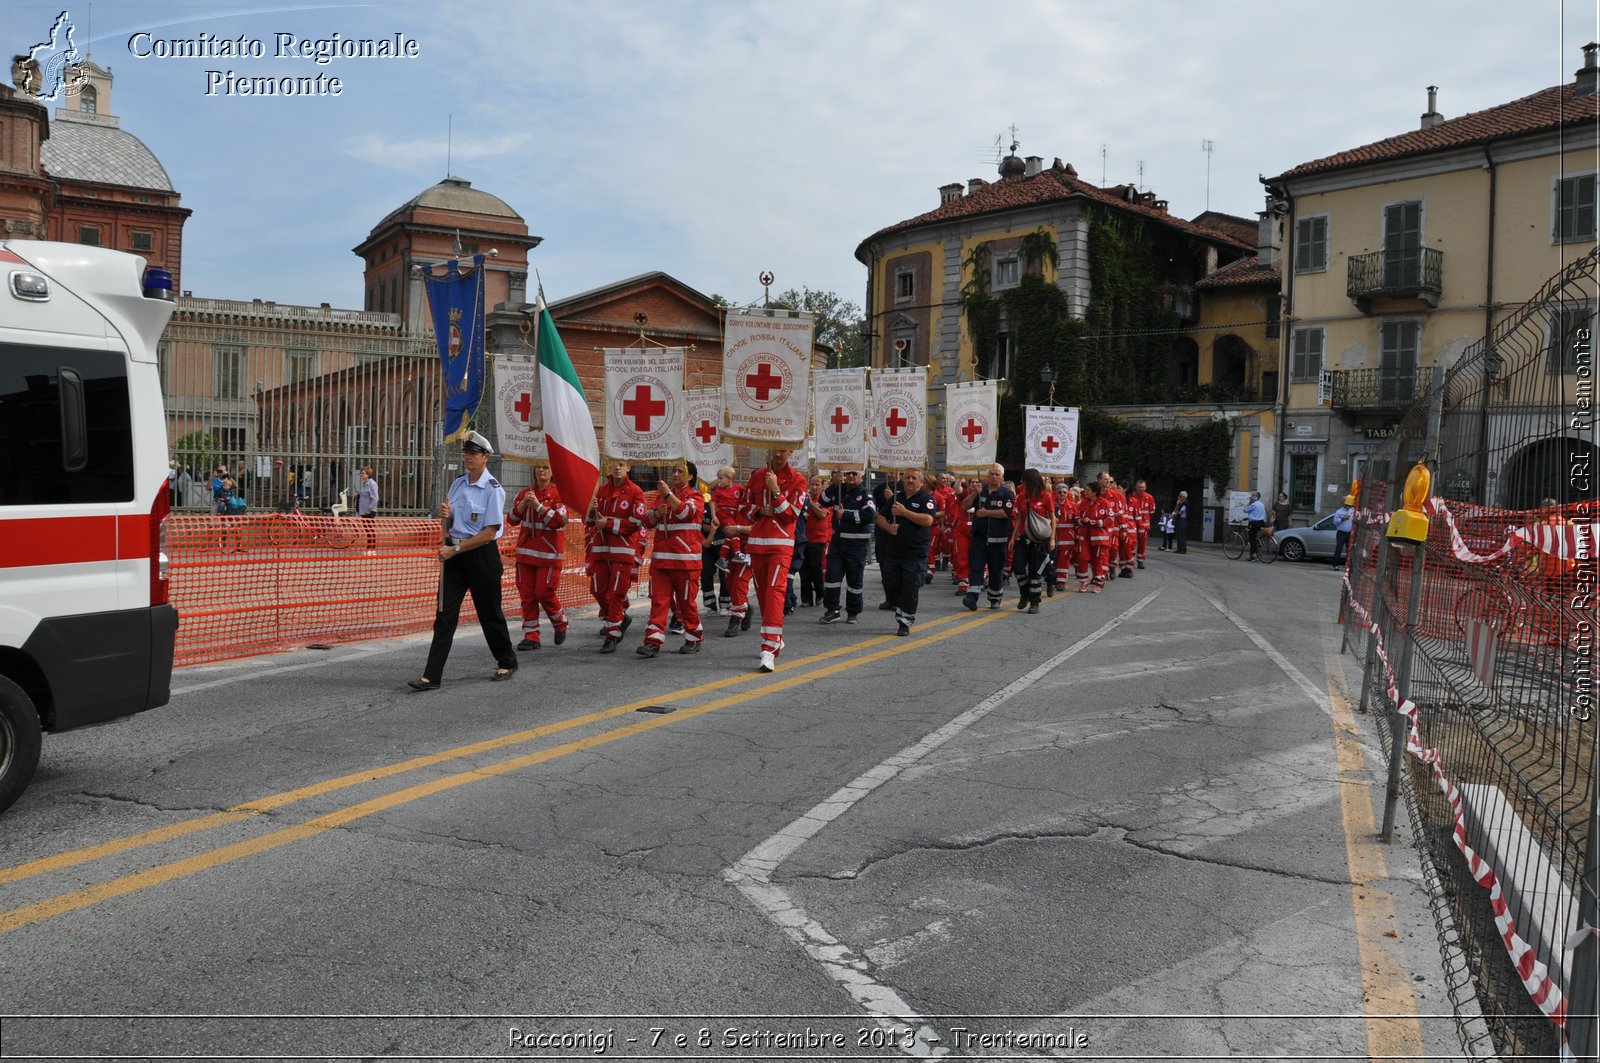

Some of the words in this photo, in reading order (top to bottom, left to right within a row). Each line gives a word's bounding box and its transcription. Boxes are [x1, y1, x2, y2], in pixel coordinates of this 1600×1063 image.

[745, 321, 771, 329] VOLONTARI
[772, 322, 781, 330] DEL
[783, 323, 809, 331] SOCCORSO
[727, 338, 748, 358] CROCE
[751, 333, 776, 342] ROSSA
[779, 337, 807, 363] ITALIANA
[754, 354, 778, 363] GINEVRA
[605, 365, 629, 373] CROCE
[498, 379, 513, 401] CROCE
[882, 389, 904, 399] ROSSA
[904, 391, 925, 417] ITALIANA
[731, 414, 781, 425] DELEGAZIONE
[738, 426, 781, 437] PAESANA
[612, 441, 641, 449] COMITATO
[622, 450, 669, 459] RACCONIGI
